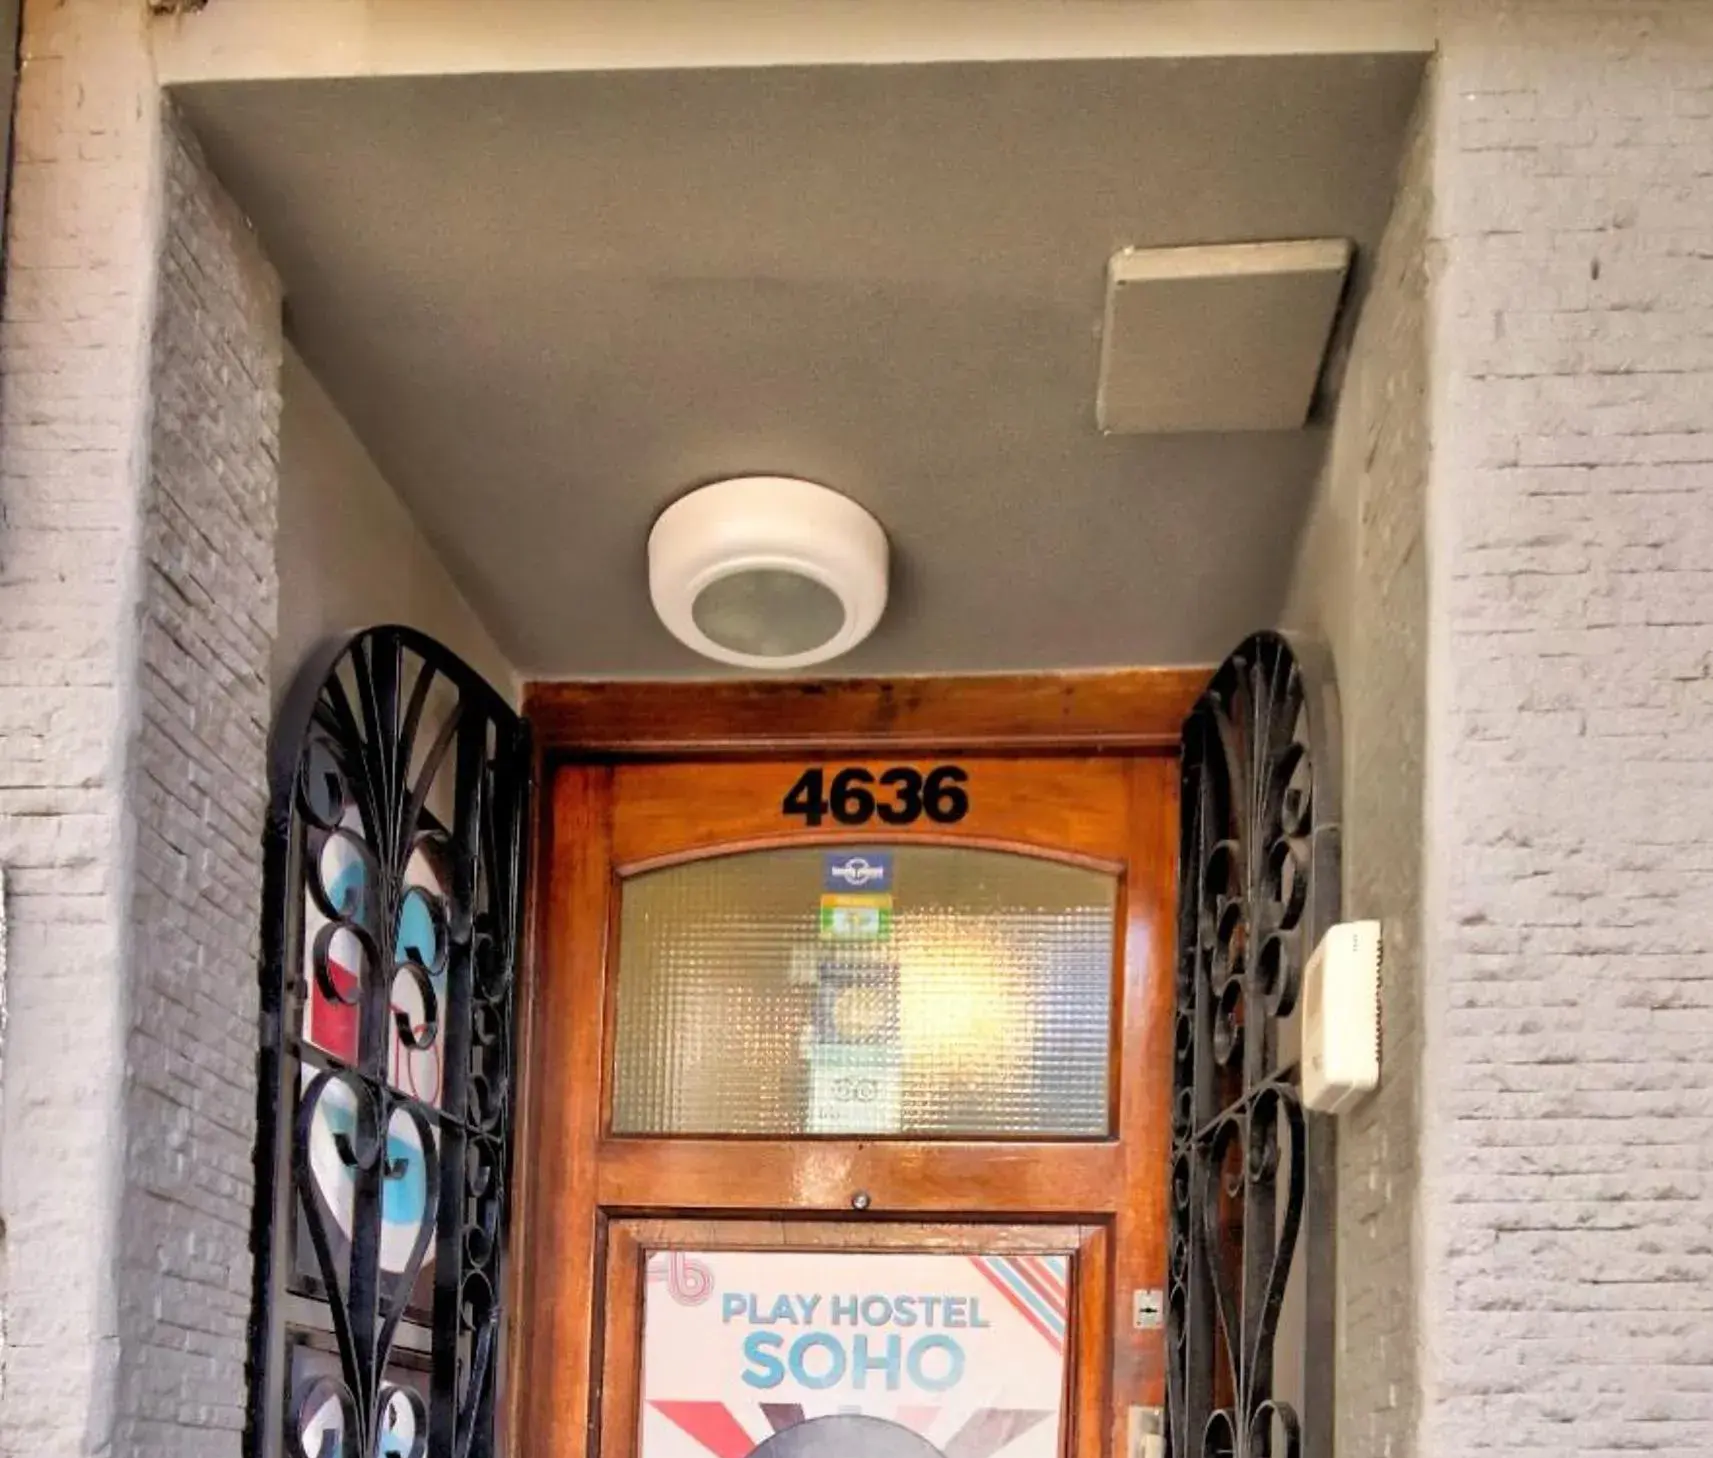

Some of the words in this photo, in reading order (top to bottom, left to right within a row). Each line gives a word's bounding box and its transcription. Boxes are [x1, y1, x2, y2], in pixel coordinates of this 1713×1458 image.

[782, 765, 969, 826] 4636
[722, 1293, 821, 1325] PLAY
[831, 1296, 990, 1328] HOSTEL
[741, 1332, 966, 1391] SOHO
